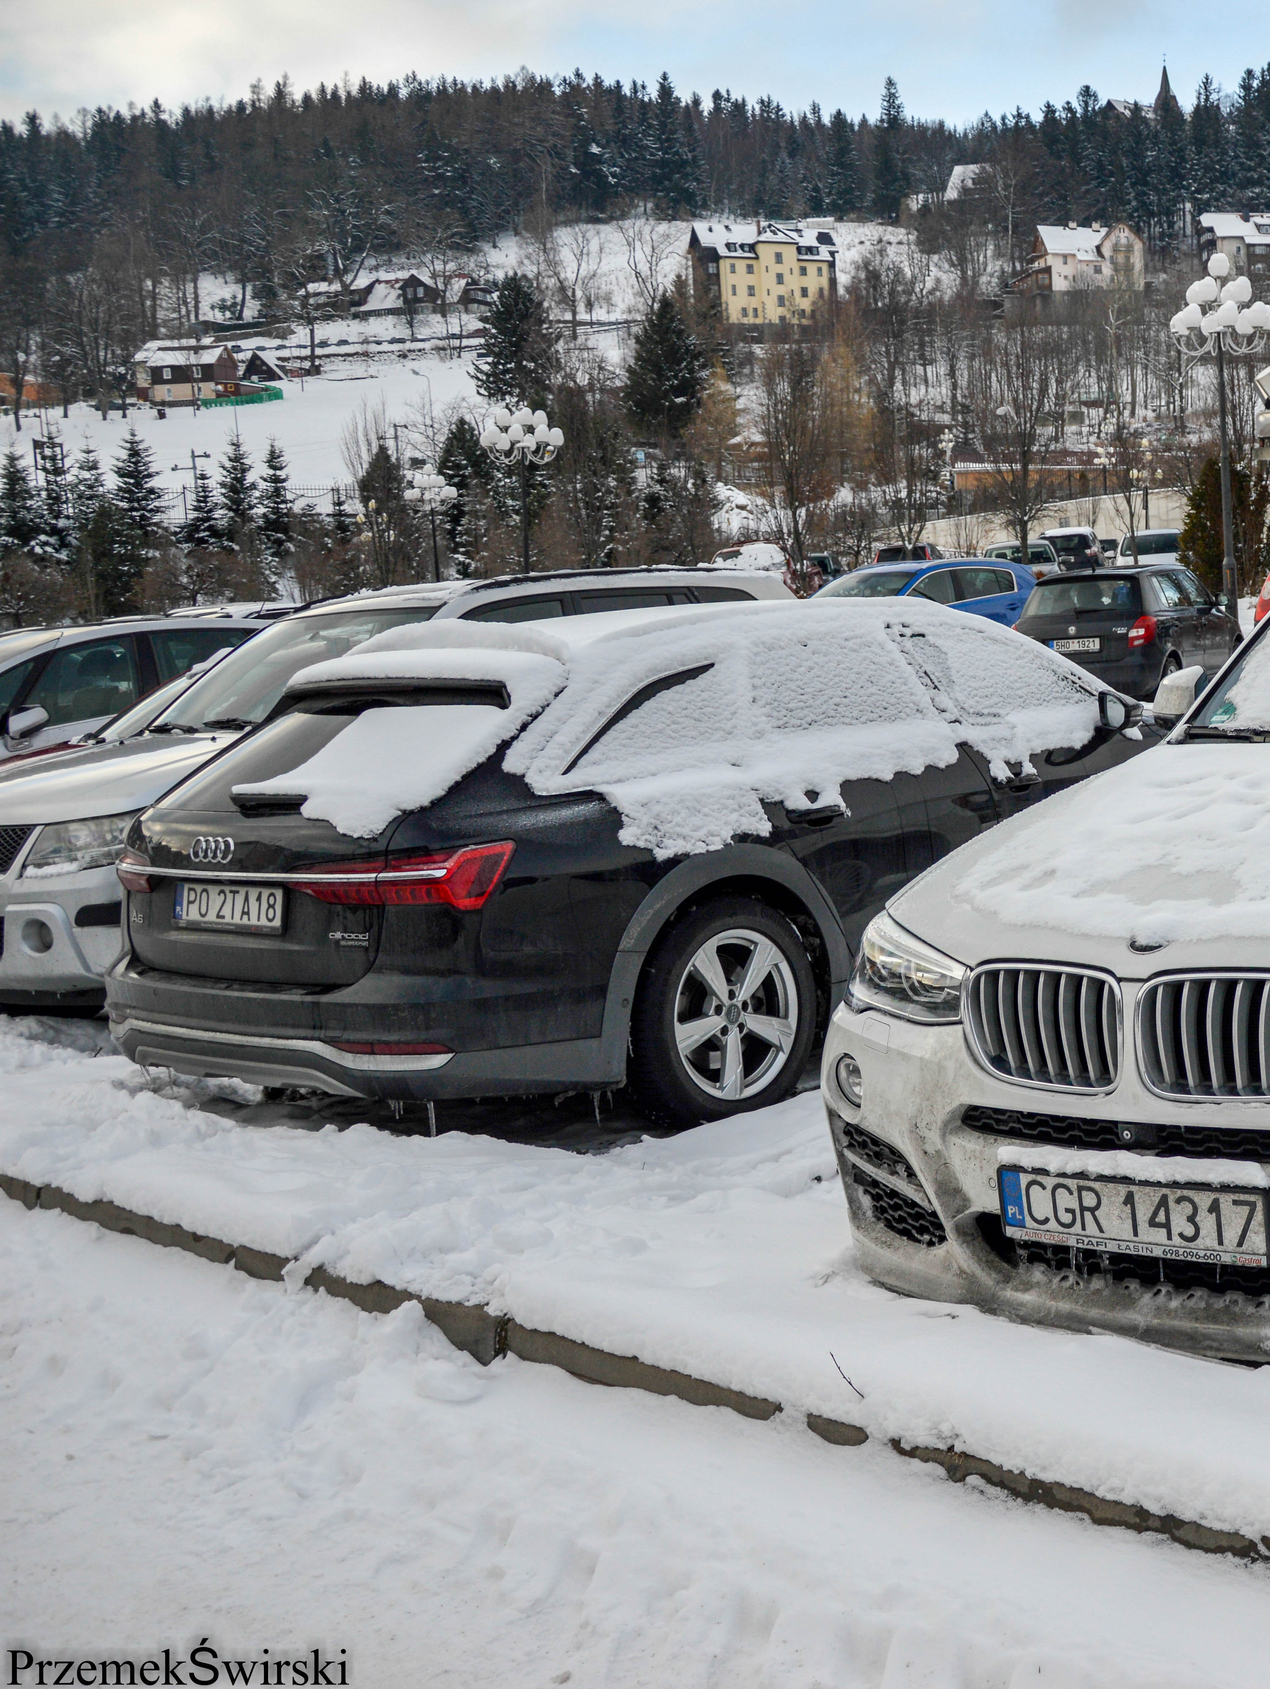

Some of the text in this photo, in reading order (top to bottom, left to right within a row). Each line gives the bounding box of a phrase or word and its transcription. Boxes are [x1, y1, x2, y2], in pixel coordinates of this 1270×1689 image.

[1077, 639, 1096, 649] 1921
[176, 905, 183, 915] PL
[186, 887, 277, 923] PO 2TA18
[131, 910, 144, 923] A6
[329, 931, 369, 940] allroad
[1007, 1205, 1023, 1220] PL
[1025, 1179, 1257, 1248] CGR 14317
[1025, 1231, 1042, 1239] AUTO
[1075, 1238, 1107, 1249] RAFI
[1117, 1243, 1153, 1254] ŁASIN
[1162, 1248, 1222, 1262] 698-096-600
[1238, 1256, 1262, 1265] Castrol
